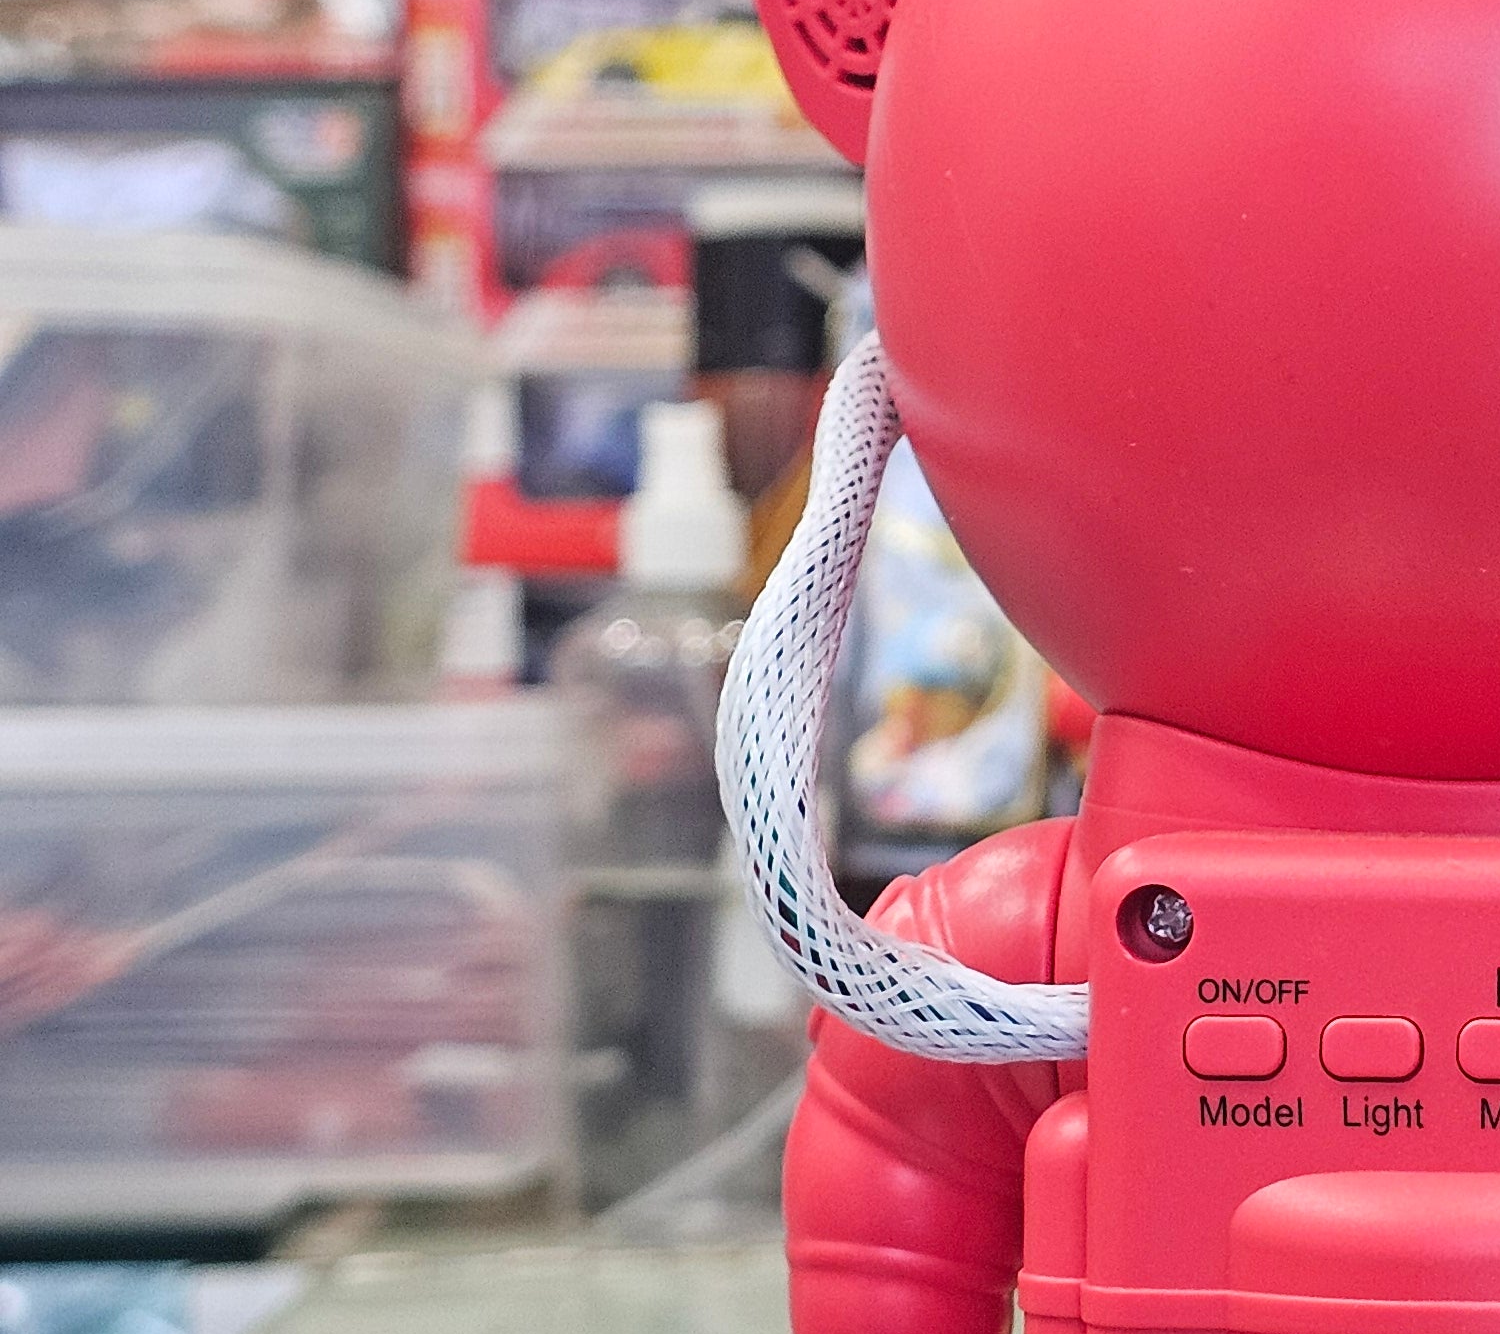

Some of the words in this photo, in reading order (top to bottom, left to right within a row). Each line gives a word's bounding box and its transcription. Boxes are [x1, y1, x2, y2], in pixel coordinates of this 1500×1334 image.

[1198, 979, 1309, 1004] ON/OFF
[1200, 1095, 1302, 1127] Model
[1343, 1096, 1423, 1136] Light
